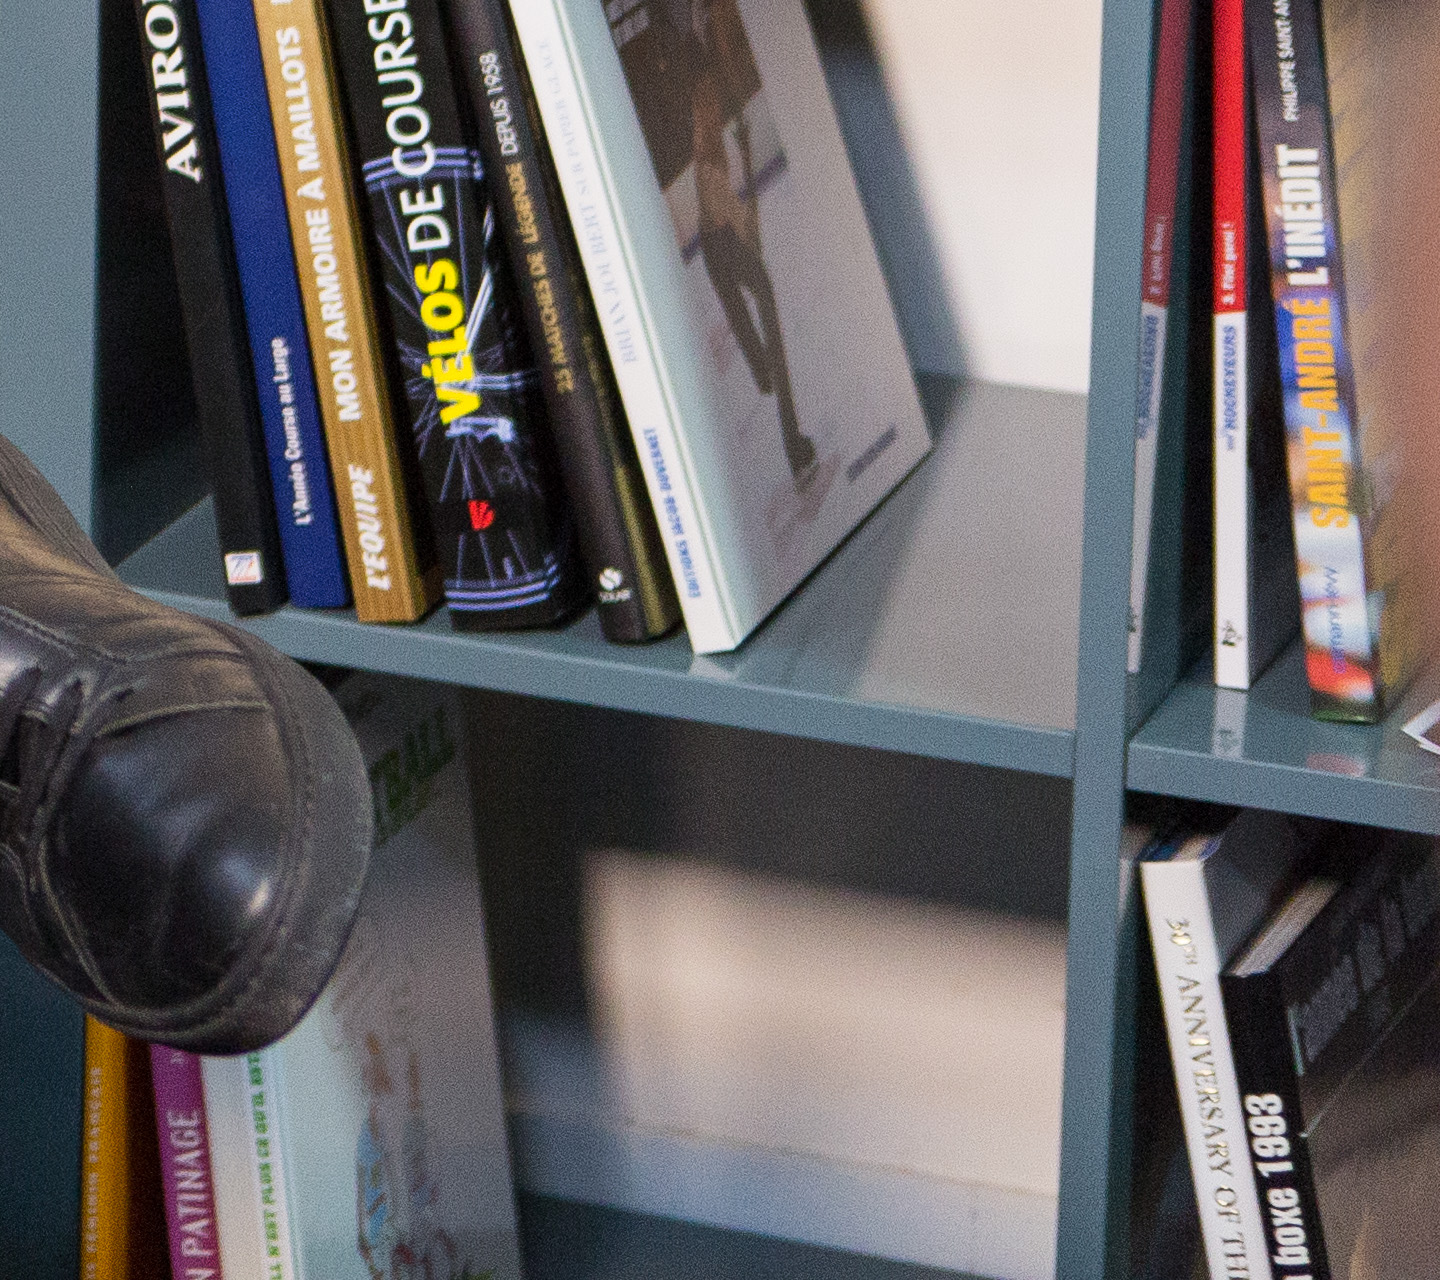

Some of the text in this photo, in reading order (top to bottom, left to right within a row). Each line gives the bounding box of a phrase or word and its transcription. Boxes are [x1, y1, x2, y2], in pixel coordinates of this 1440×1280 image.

[276, 26, 321, 173] MAILLOTS
[478, 49, 503, 96] 1958
[1279, 60, 1298, 122] PHILIPPE
[489, 96, 518, 158] DEPUIS
[400, 183, 452, 253] DE
[305, 208, 350, 342] ARMOIRE
[526, 251, 548, 277] DE
[414, 257, 481, 425] VÉLOS
[532, 277, 568, 365] MATCHES
[328, 348, 362, 422] MON
[1222, 325, 1237, 430] HOCKEYEURS
[282, 405, 303, 461] Course
[1175, 974, 1234, 1178] ANNIVERSARY
[1215, 1184, 1242, 1224] OF
[1243, 1092, 1295, 1177] 1993
[166, 1109, 214, 1257] PATINAGE
[1267, 1186, 1310, 1266] boxe
